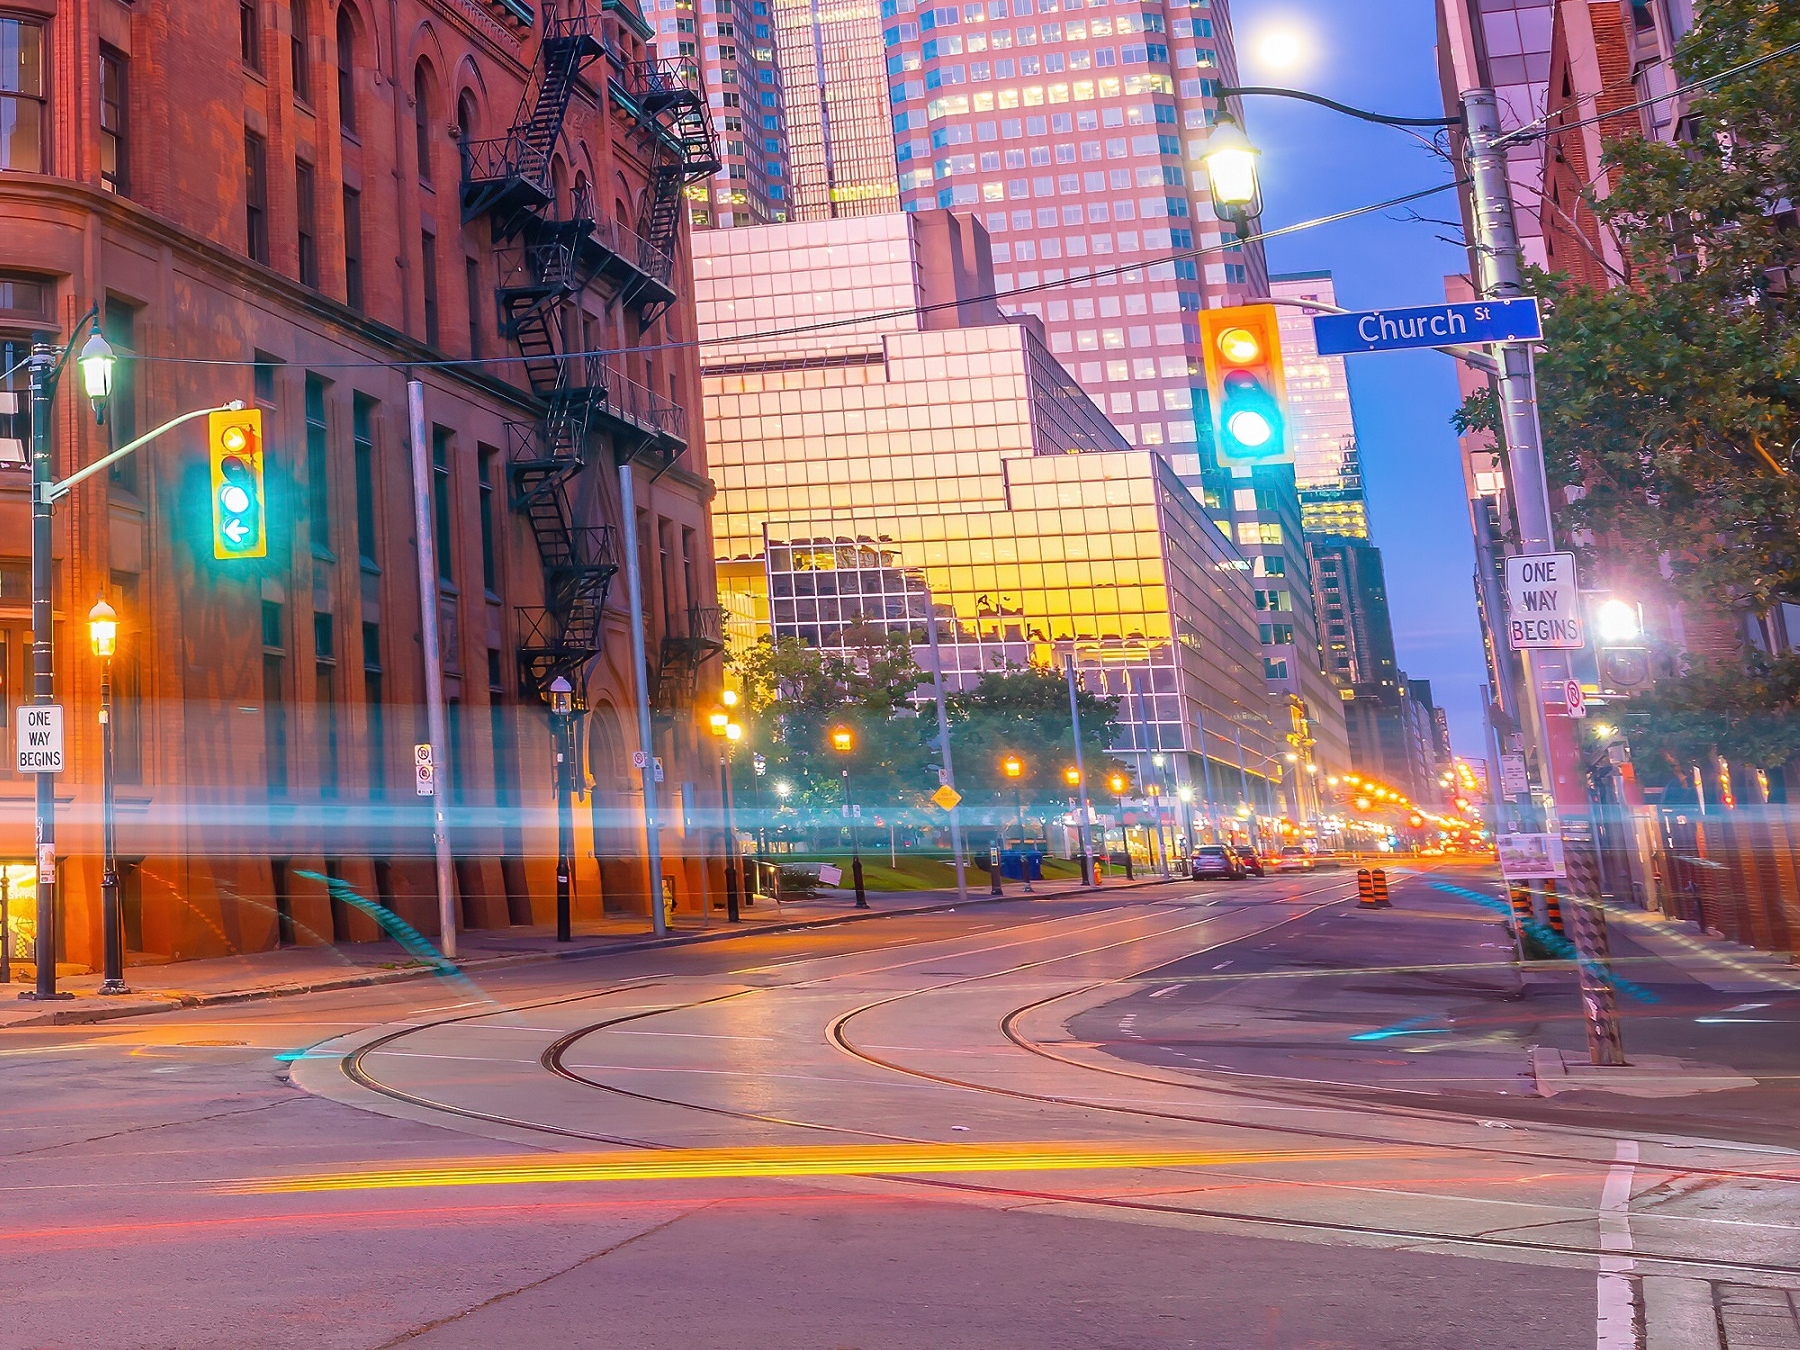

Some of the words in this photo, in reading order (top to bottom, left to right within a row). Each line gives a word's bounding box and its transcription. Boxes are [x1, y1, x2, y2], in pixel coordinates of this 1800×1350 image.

[1358, 309, 1467, 342] Church
[1474, 306, 1491, 321] St
[1522, 561, 1557, 583] ONE
[1522, 590, 1557, 611] WAY
[1511, 619, 1578, 640] BEGINS
[28, 711, 51, 726] ONE
[28, 731, 51, 746] WAY
[20, 751, 61, 767] BEGINS
